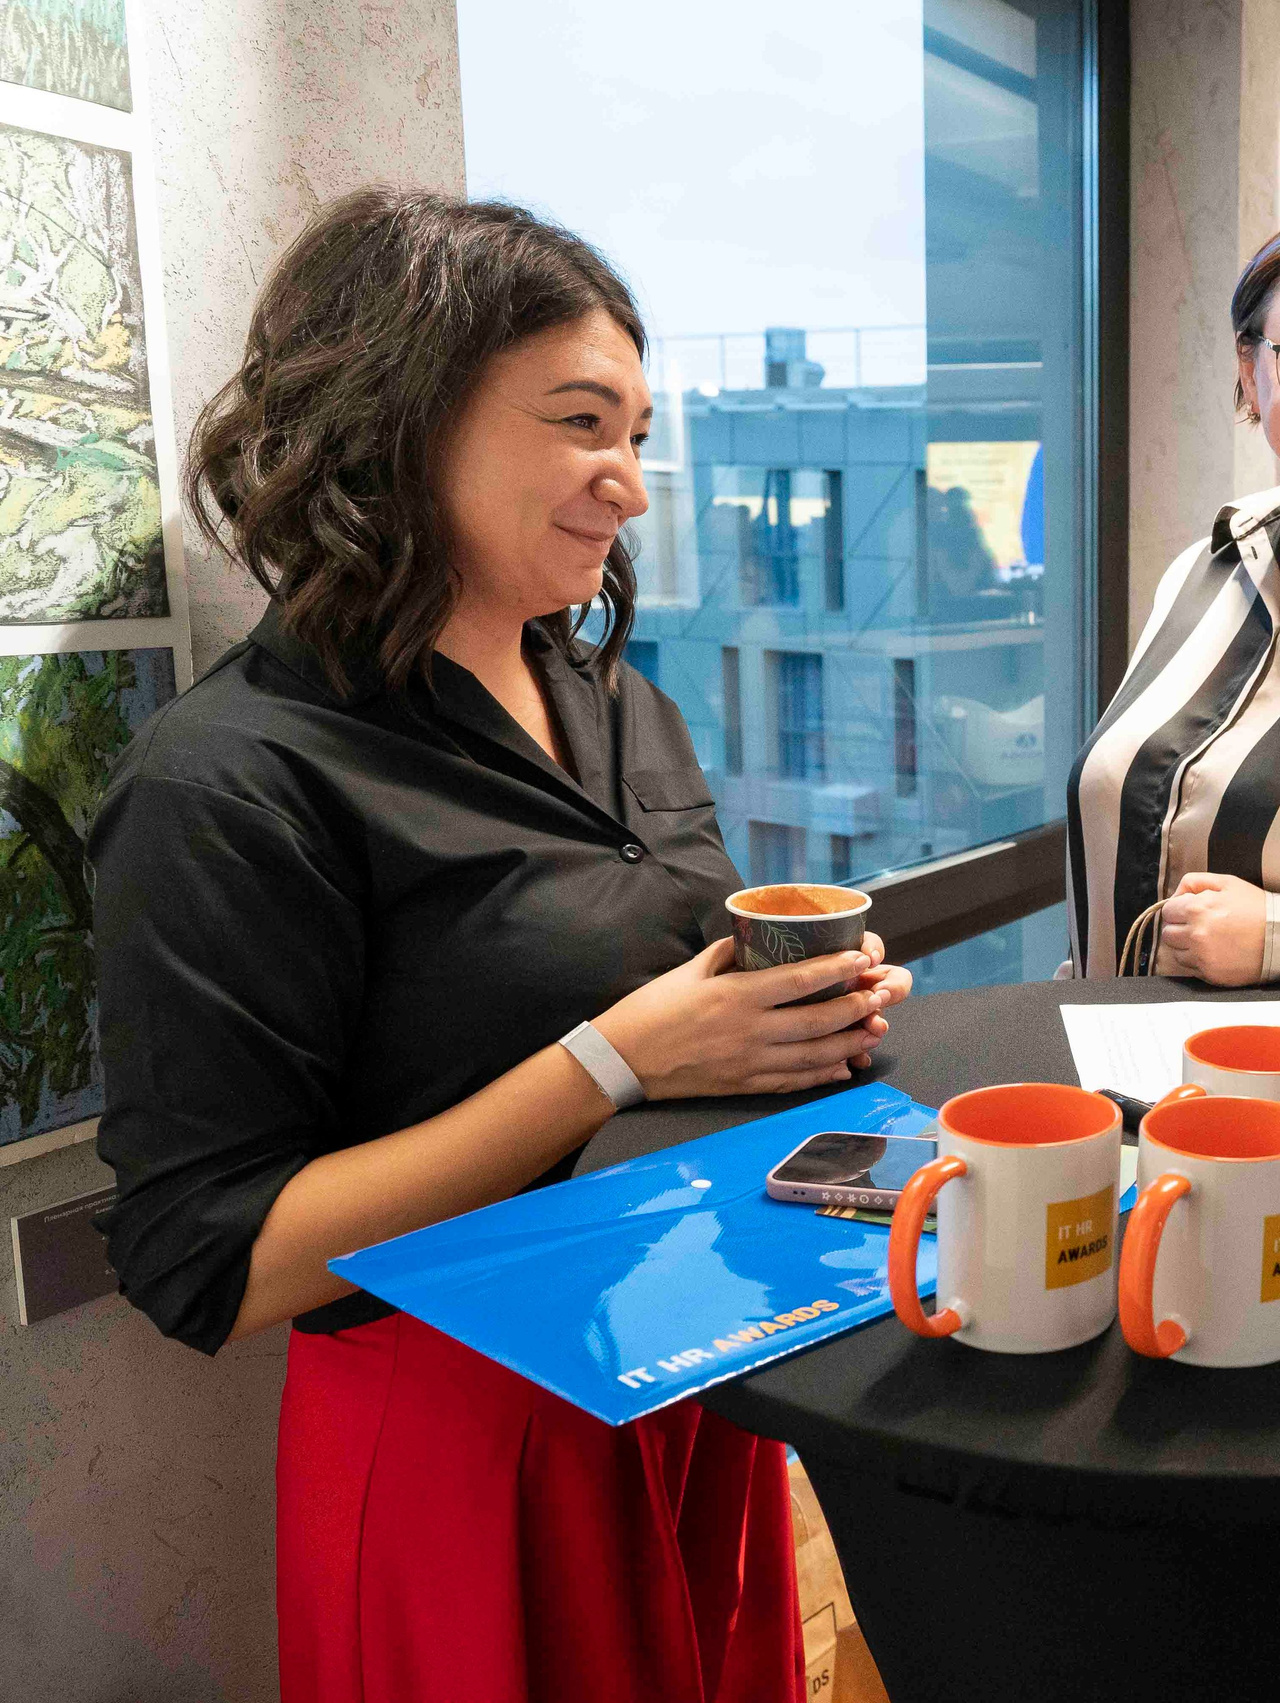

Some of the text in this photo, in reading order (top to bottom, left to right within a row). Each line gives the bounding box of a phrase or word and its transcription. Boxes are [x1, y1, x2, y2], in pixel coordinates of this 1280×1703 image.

[1058, 1220, 1093, 1240] IT HR
[1058, 1235, 1108, 1264] AWARDS
[617, 1299, 840, 1389] IT HR AWARDS
